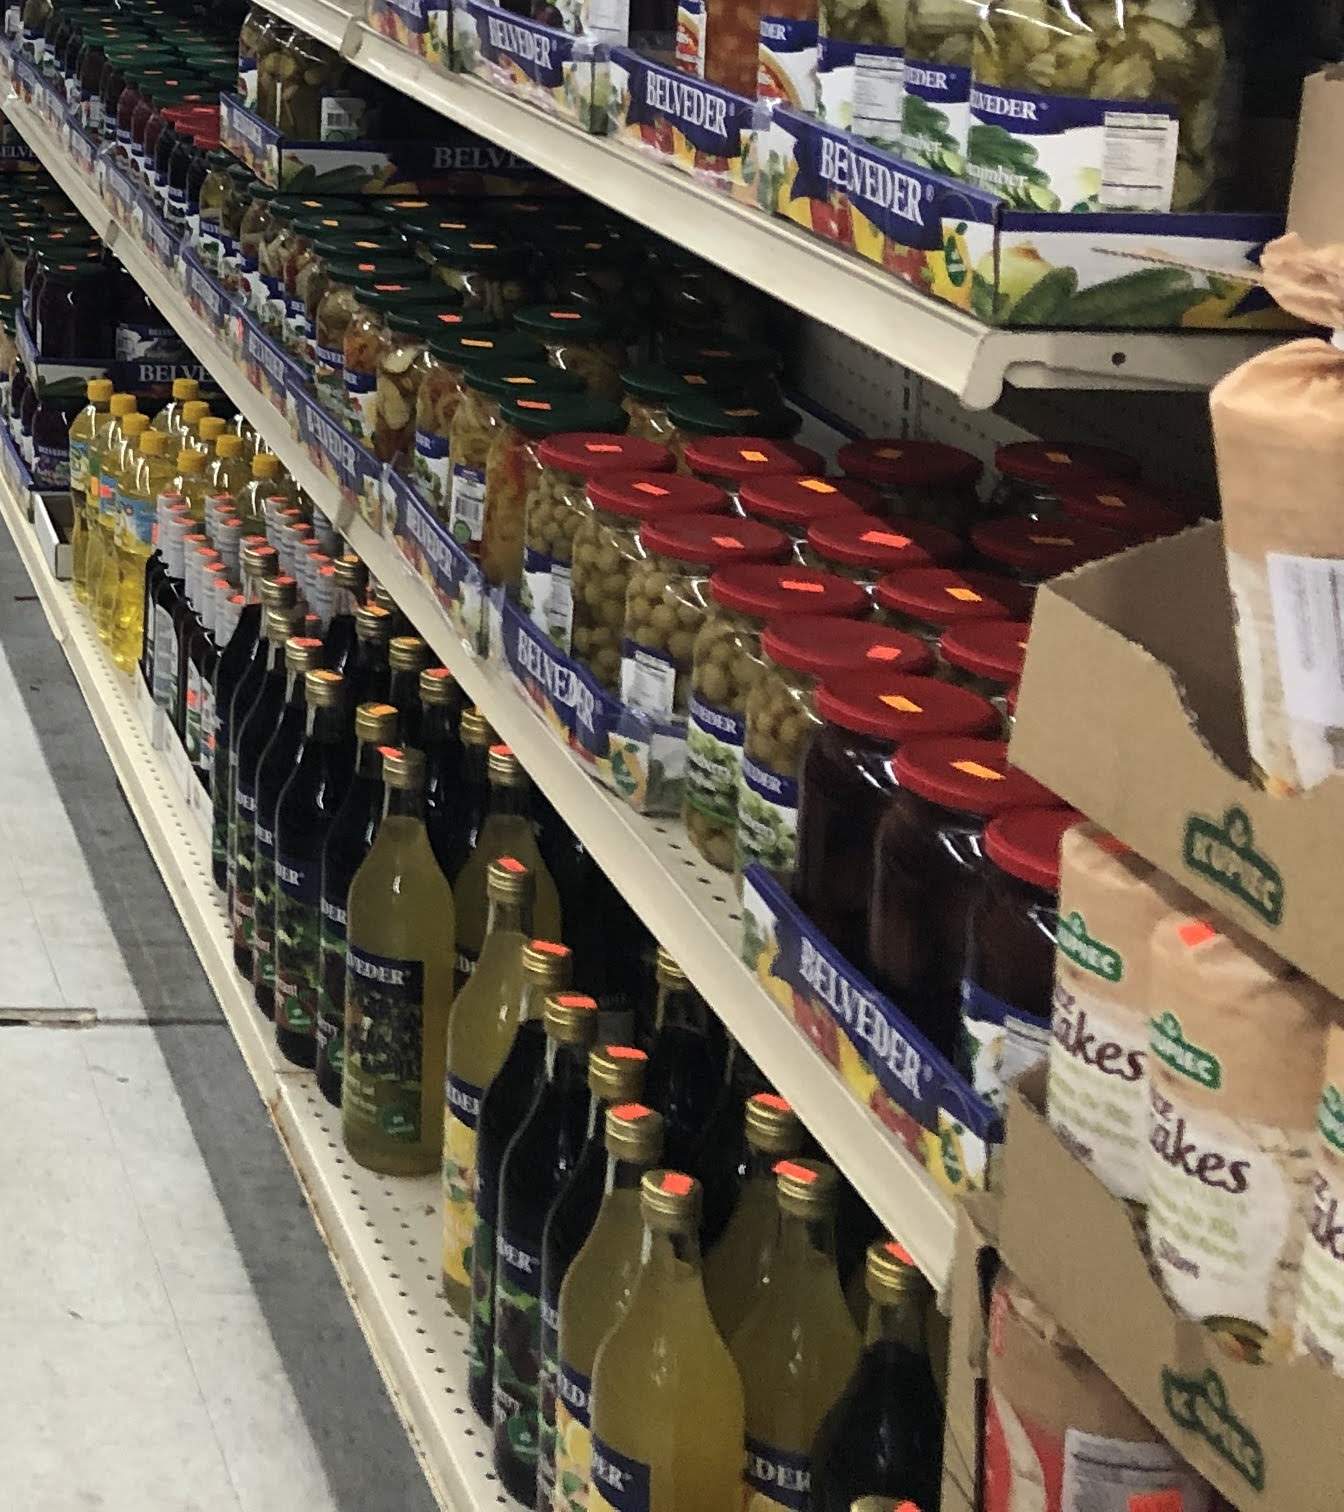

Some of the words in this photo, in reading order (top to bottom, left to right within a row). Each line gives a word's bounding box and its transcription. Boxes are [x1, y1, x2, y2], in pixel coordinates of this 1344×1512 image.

[489, 16, 553, 71] BELVEDER
[645, 69, 729, 139] BELVEDER
[433, 145, 534, 171] BELVE
[819, 136, 925, 229] BELVEDER
[139, 364, 213, 383] BELVE
[517, 628, 597, 732] BELVEDER
[799, 936, 923, 1101] BELVEDER
